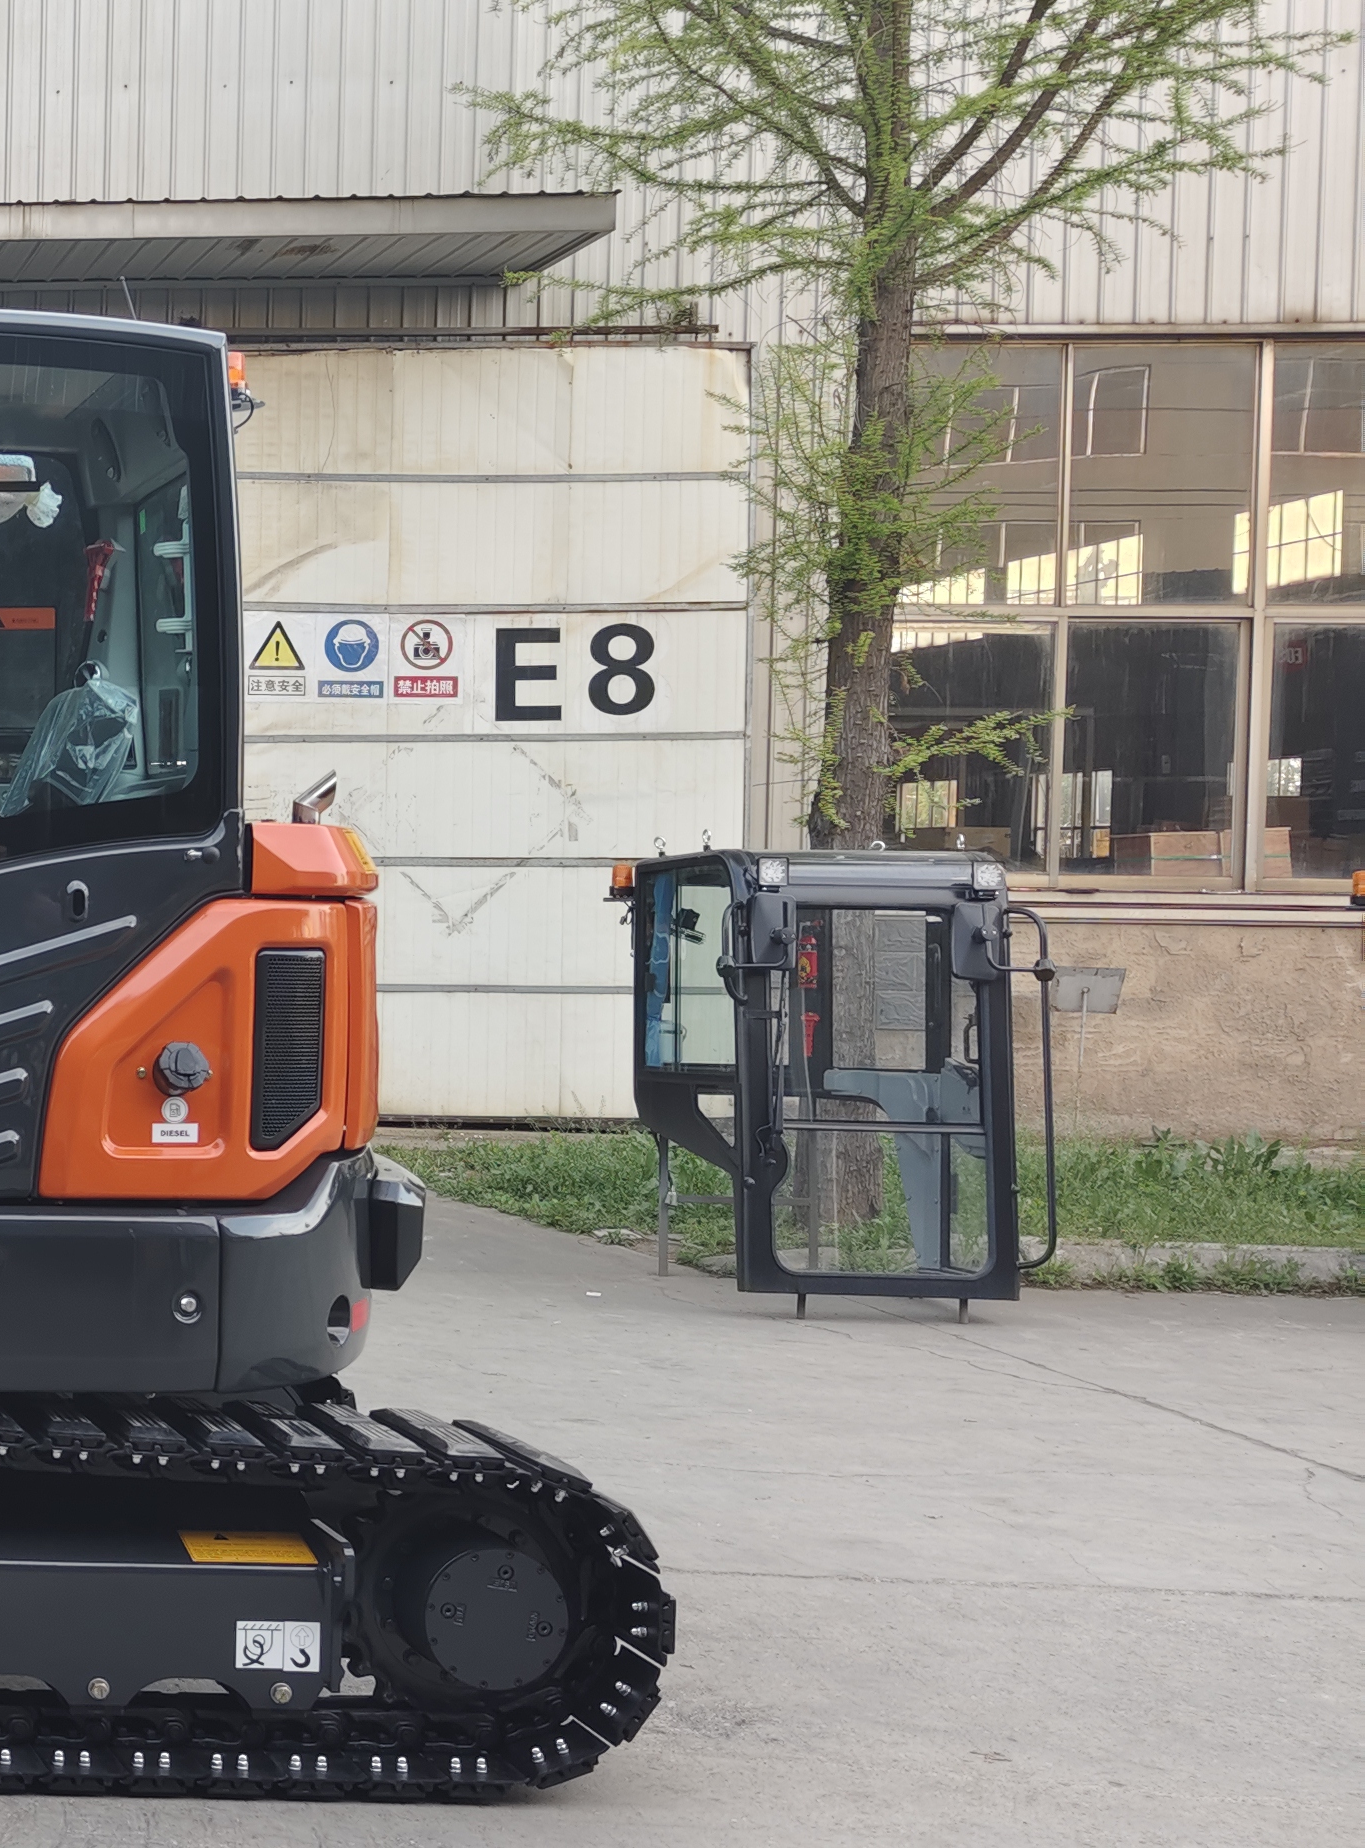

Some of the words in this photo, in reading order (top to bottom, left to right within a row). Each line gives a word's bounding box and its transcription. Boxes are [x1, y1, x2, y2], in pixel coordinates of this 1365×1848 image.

[495, 623, 655, 721] E8
[250, 679, 304, 692] 注意安全
[322, 684, 380, 696] 必须戴安全帽
[397, 680, 454, 695] 禁止拍照
